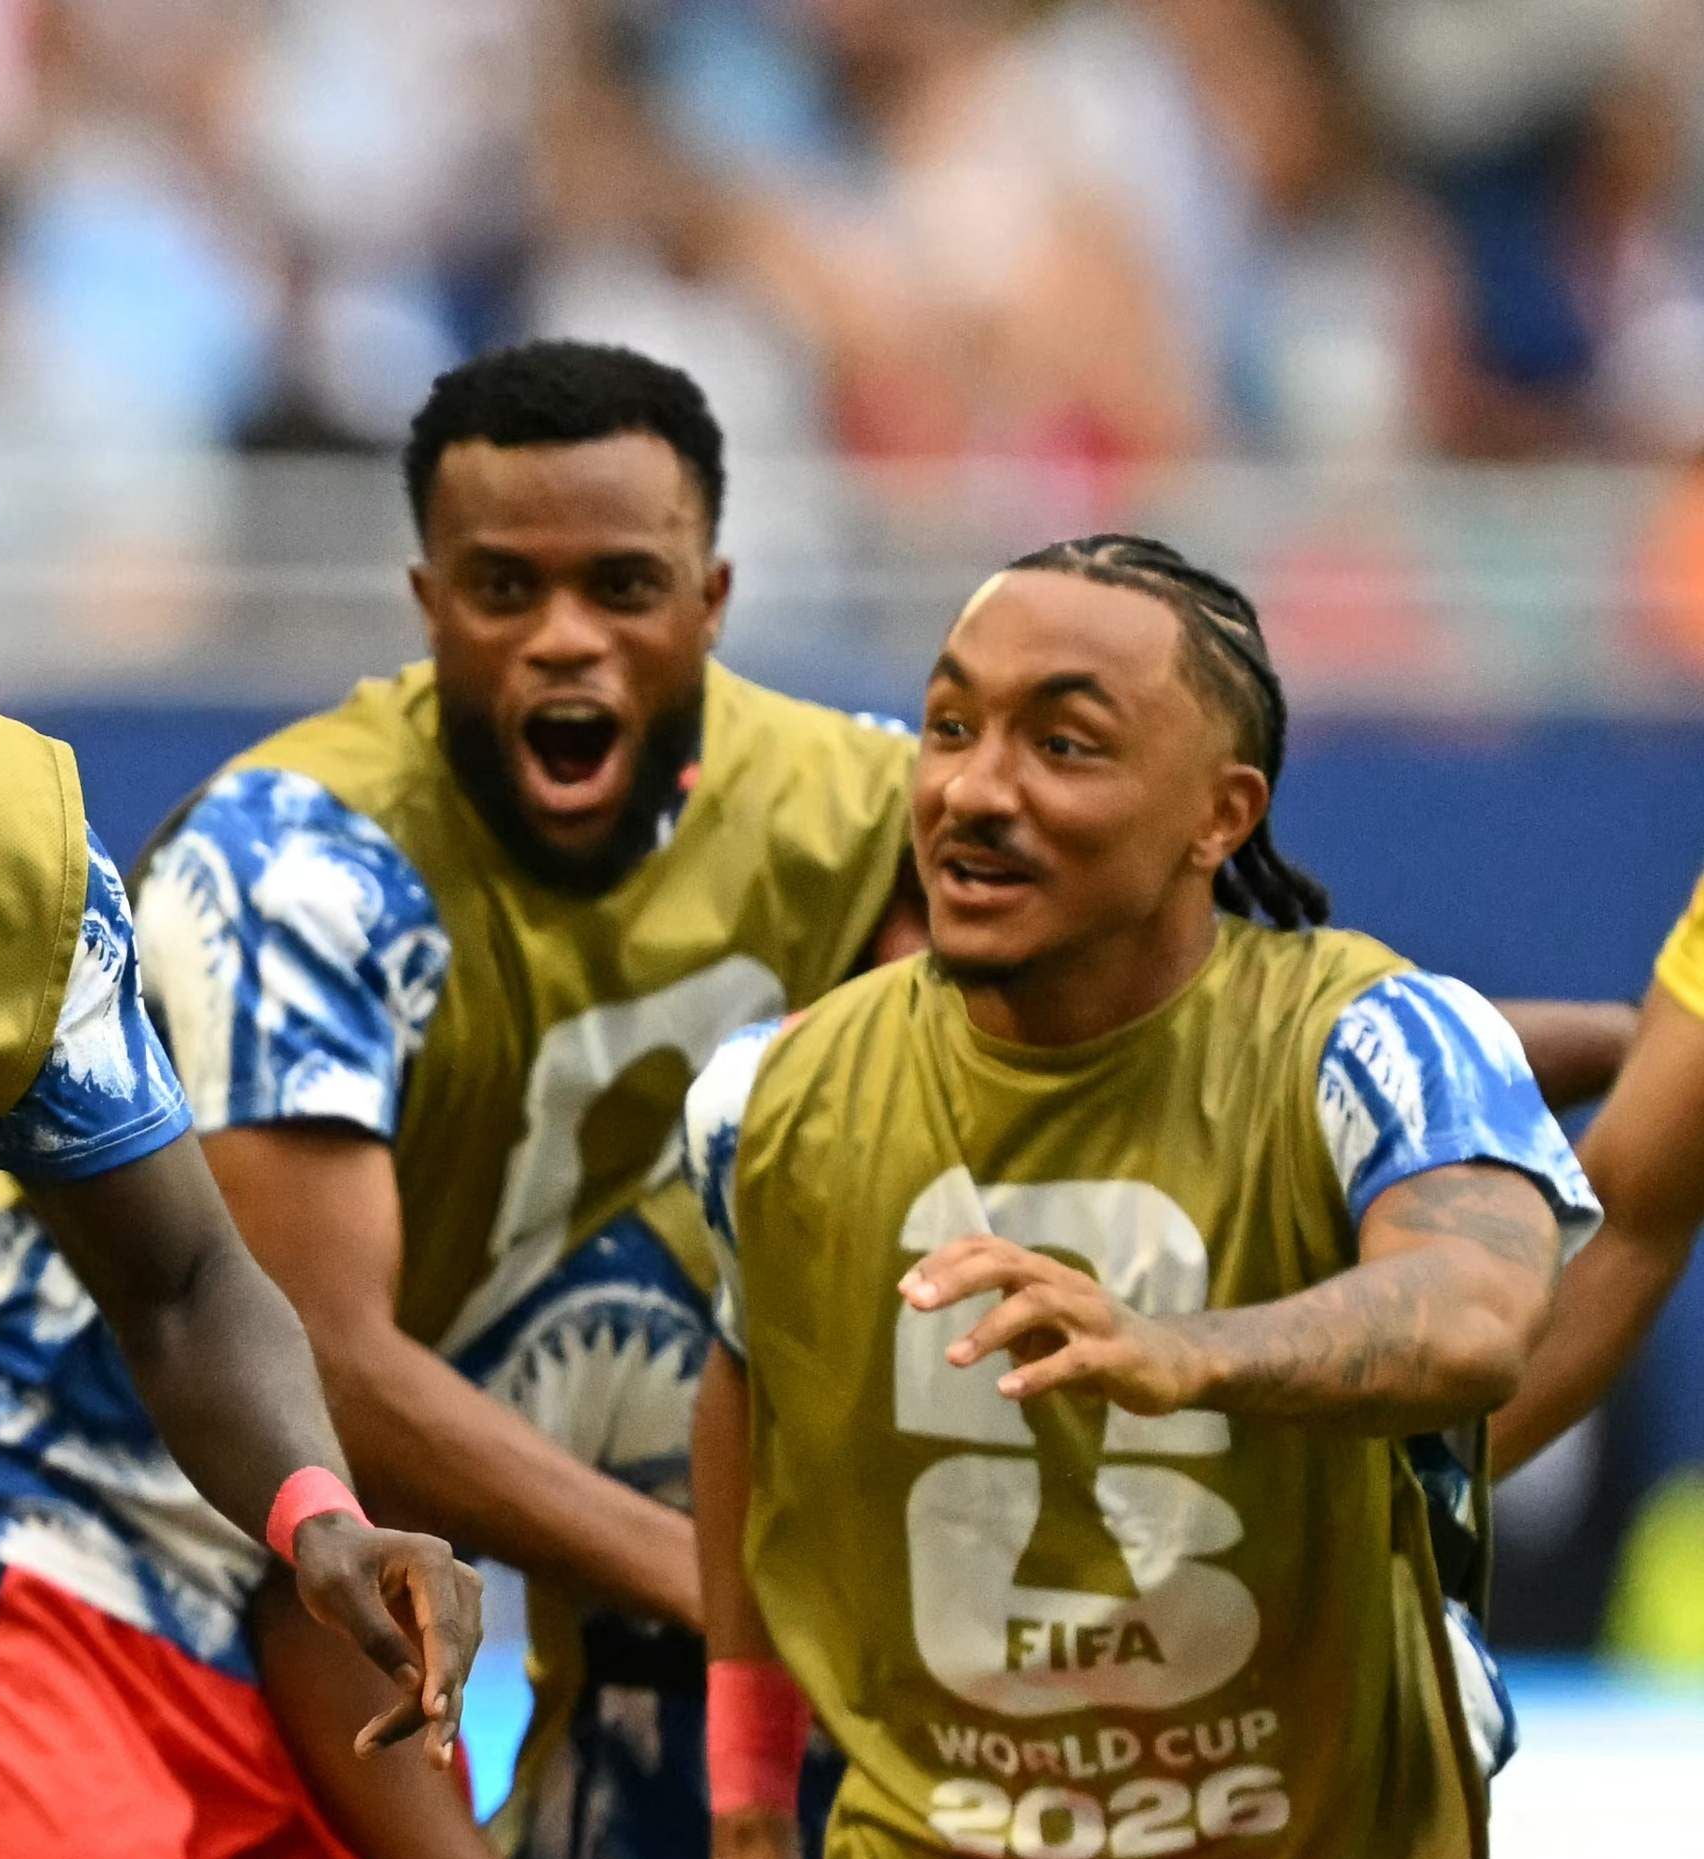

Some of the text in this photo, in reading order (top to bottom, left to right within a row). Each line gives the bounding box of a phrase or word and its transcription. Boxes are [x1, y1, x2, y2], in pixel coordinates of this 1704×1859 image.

[1004, 1617, 1167, 1672] FIFA
[928, 1708, 1278, 1779] WORLD CUP
